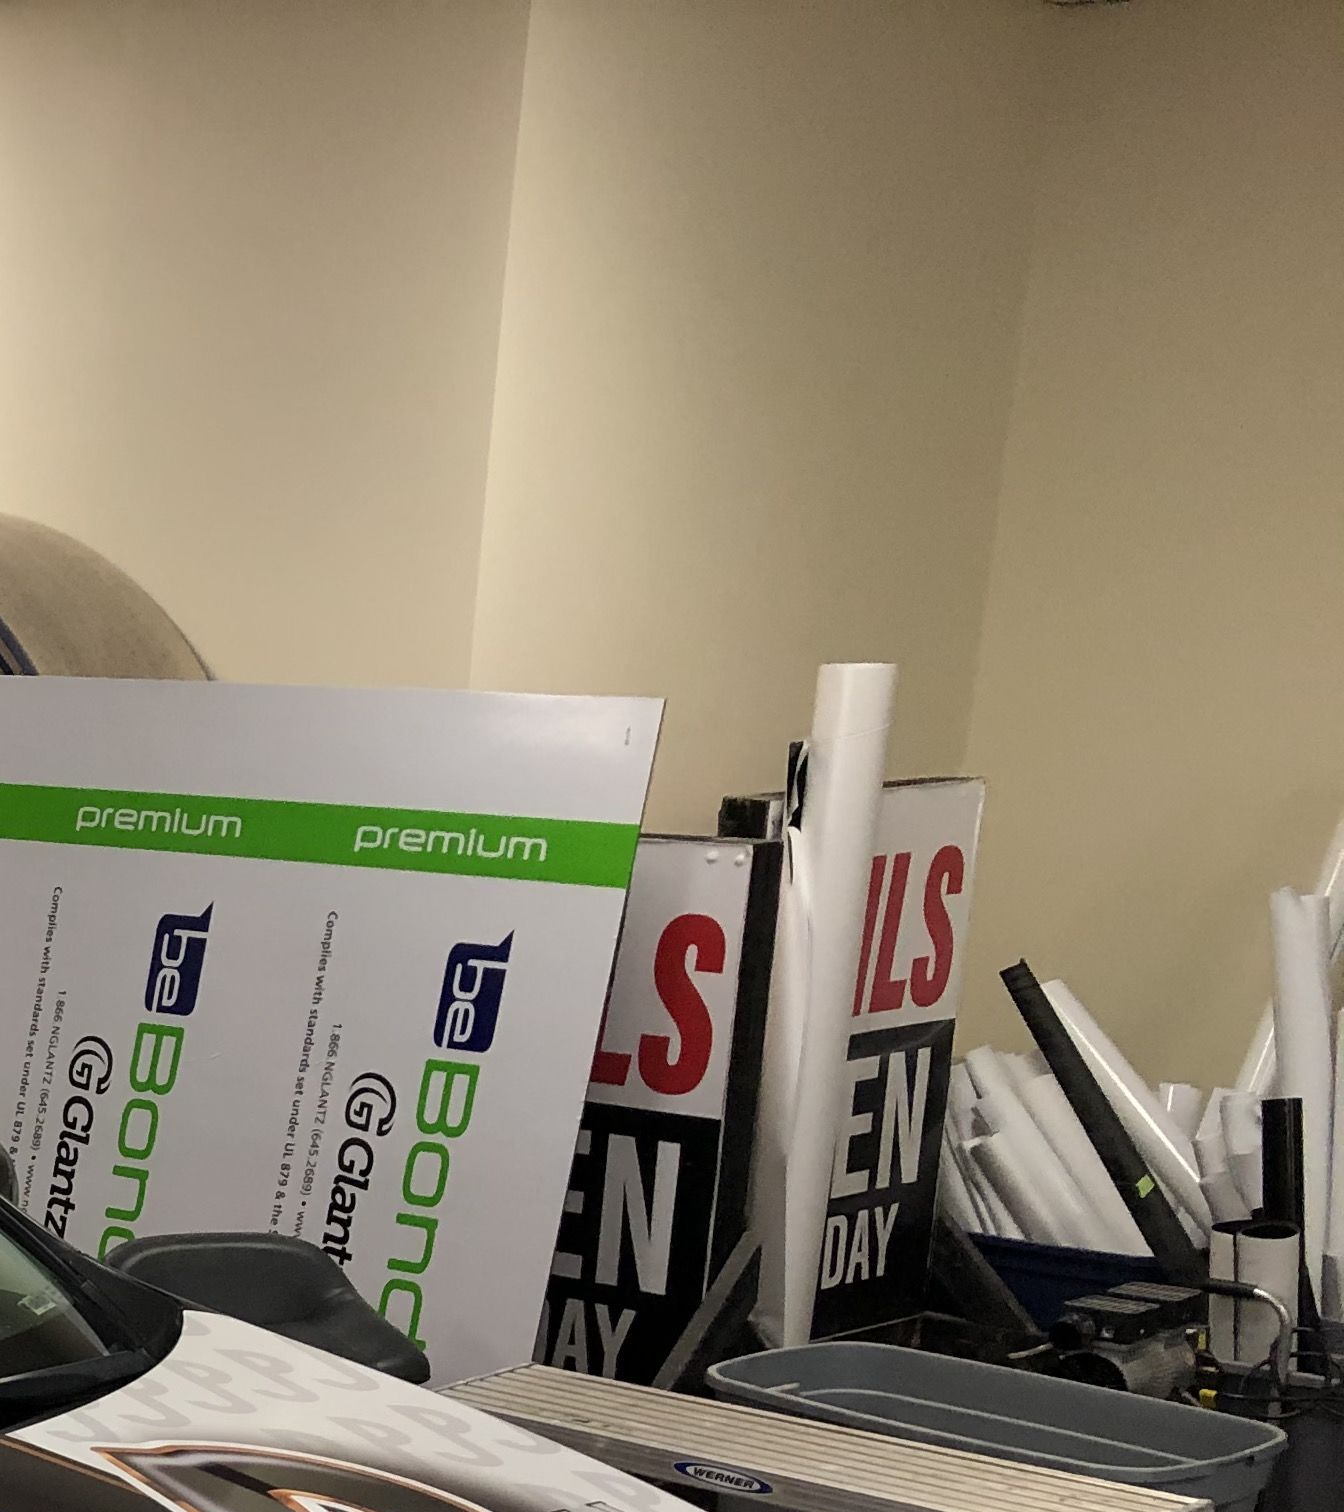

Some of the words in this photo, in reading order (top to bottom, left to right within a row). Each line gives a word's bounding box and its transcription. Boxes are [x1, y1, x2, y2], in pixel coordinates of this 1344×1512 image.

[75, 804, 243, 838] premium
[353, 824, 548, 862] premium
[46, 886, 63, 942] Complies
[317, 911, 338, 972] Complies
[40, 946, 51, 974] with
[29, 977, 47, 1037] standards
[312, 975, 325, 1005] with
[25, 1040, 36, 1058] set
[299, 1009, 319, 1073] standards
[19, 1062, 31, 1097] under
[295, 1077, 305, 1095] set
[15, 1101, 26, 1116] UL
[287, 1099, 301, 1138] under
[830, 1046, 931, 1200] EN
[11, 1120, 23, 1143] 879
[43, 1095, 94, 1240] Glantz
[282, 1143, 296, 1159] UL
[278, 1164, 291, 1186] 879
[271, 1204, 282, 1226] the
[320, 1137, 375, 1266] Glant
[820, 1202, 900, 1290] DAY
[692, 1466, 755, 1489] WERNER
